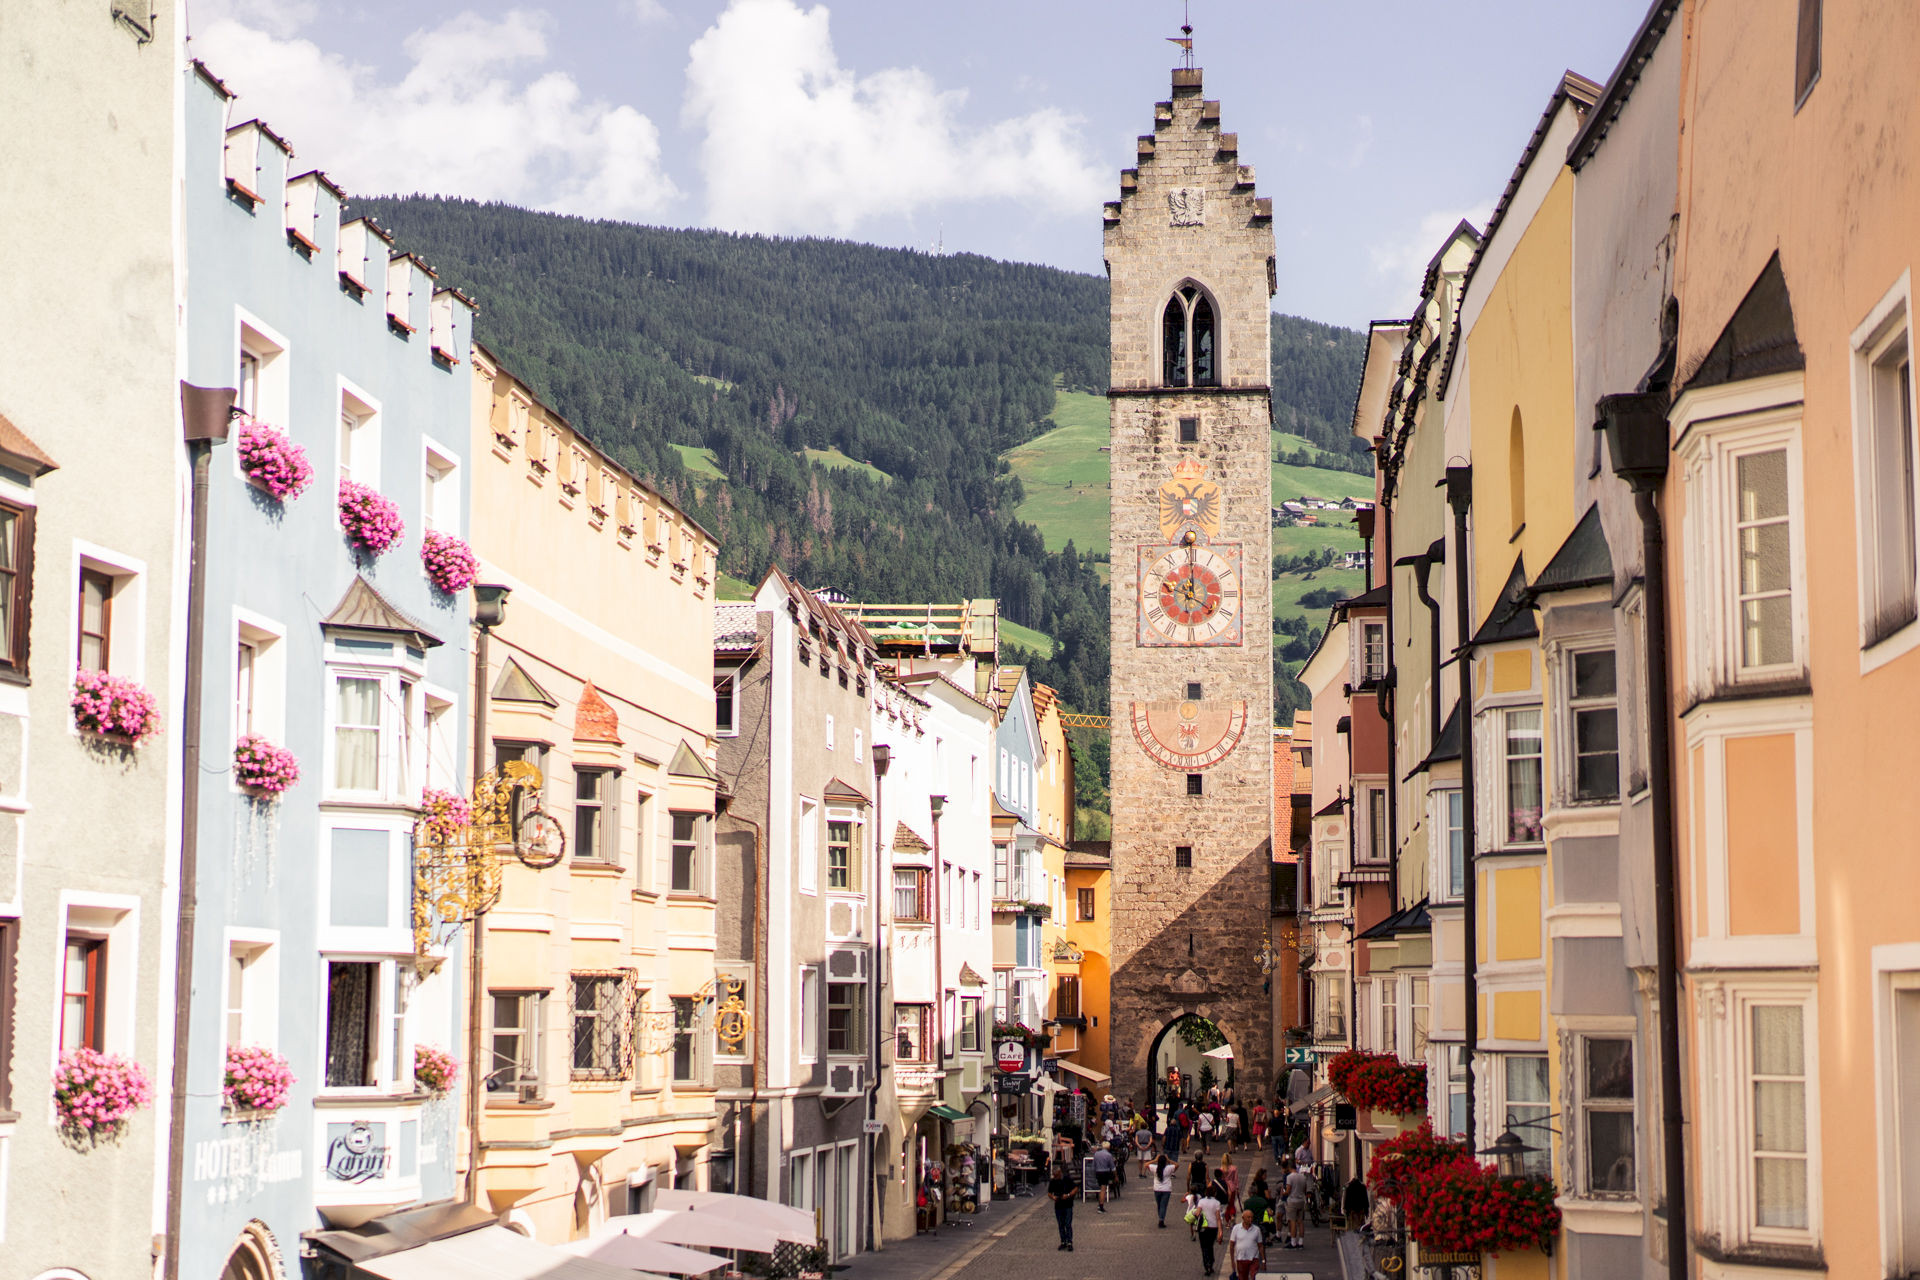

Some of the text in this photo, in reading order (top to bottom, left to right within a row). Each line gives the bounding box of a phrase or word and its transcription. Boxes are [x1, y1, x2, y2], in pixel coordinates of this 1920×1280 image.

[1149, 569, 1164, 581] X
[1218, 569, 1232, 580] II
[1143, 590, 1158, 599] IX
[1223, 590, 1238, 598] III
[1207, 622, 1217, 637] V
[999, 1052, 1024, 1060] CAFÉ
[193, 1136, 252, 1182] HOTEL
